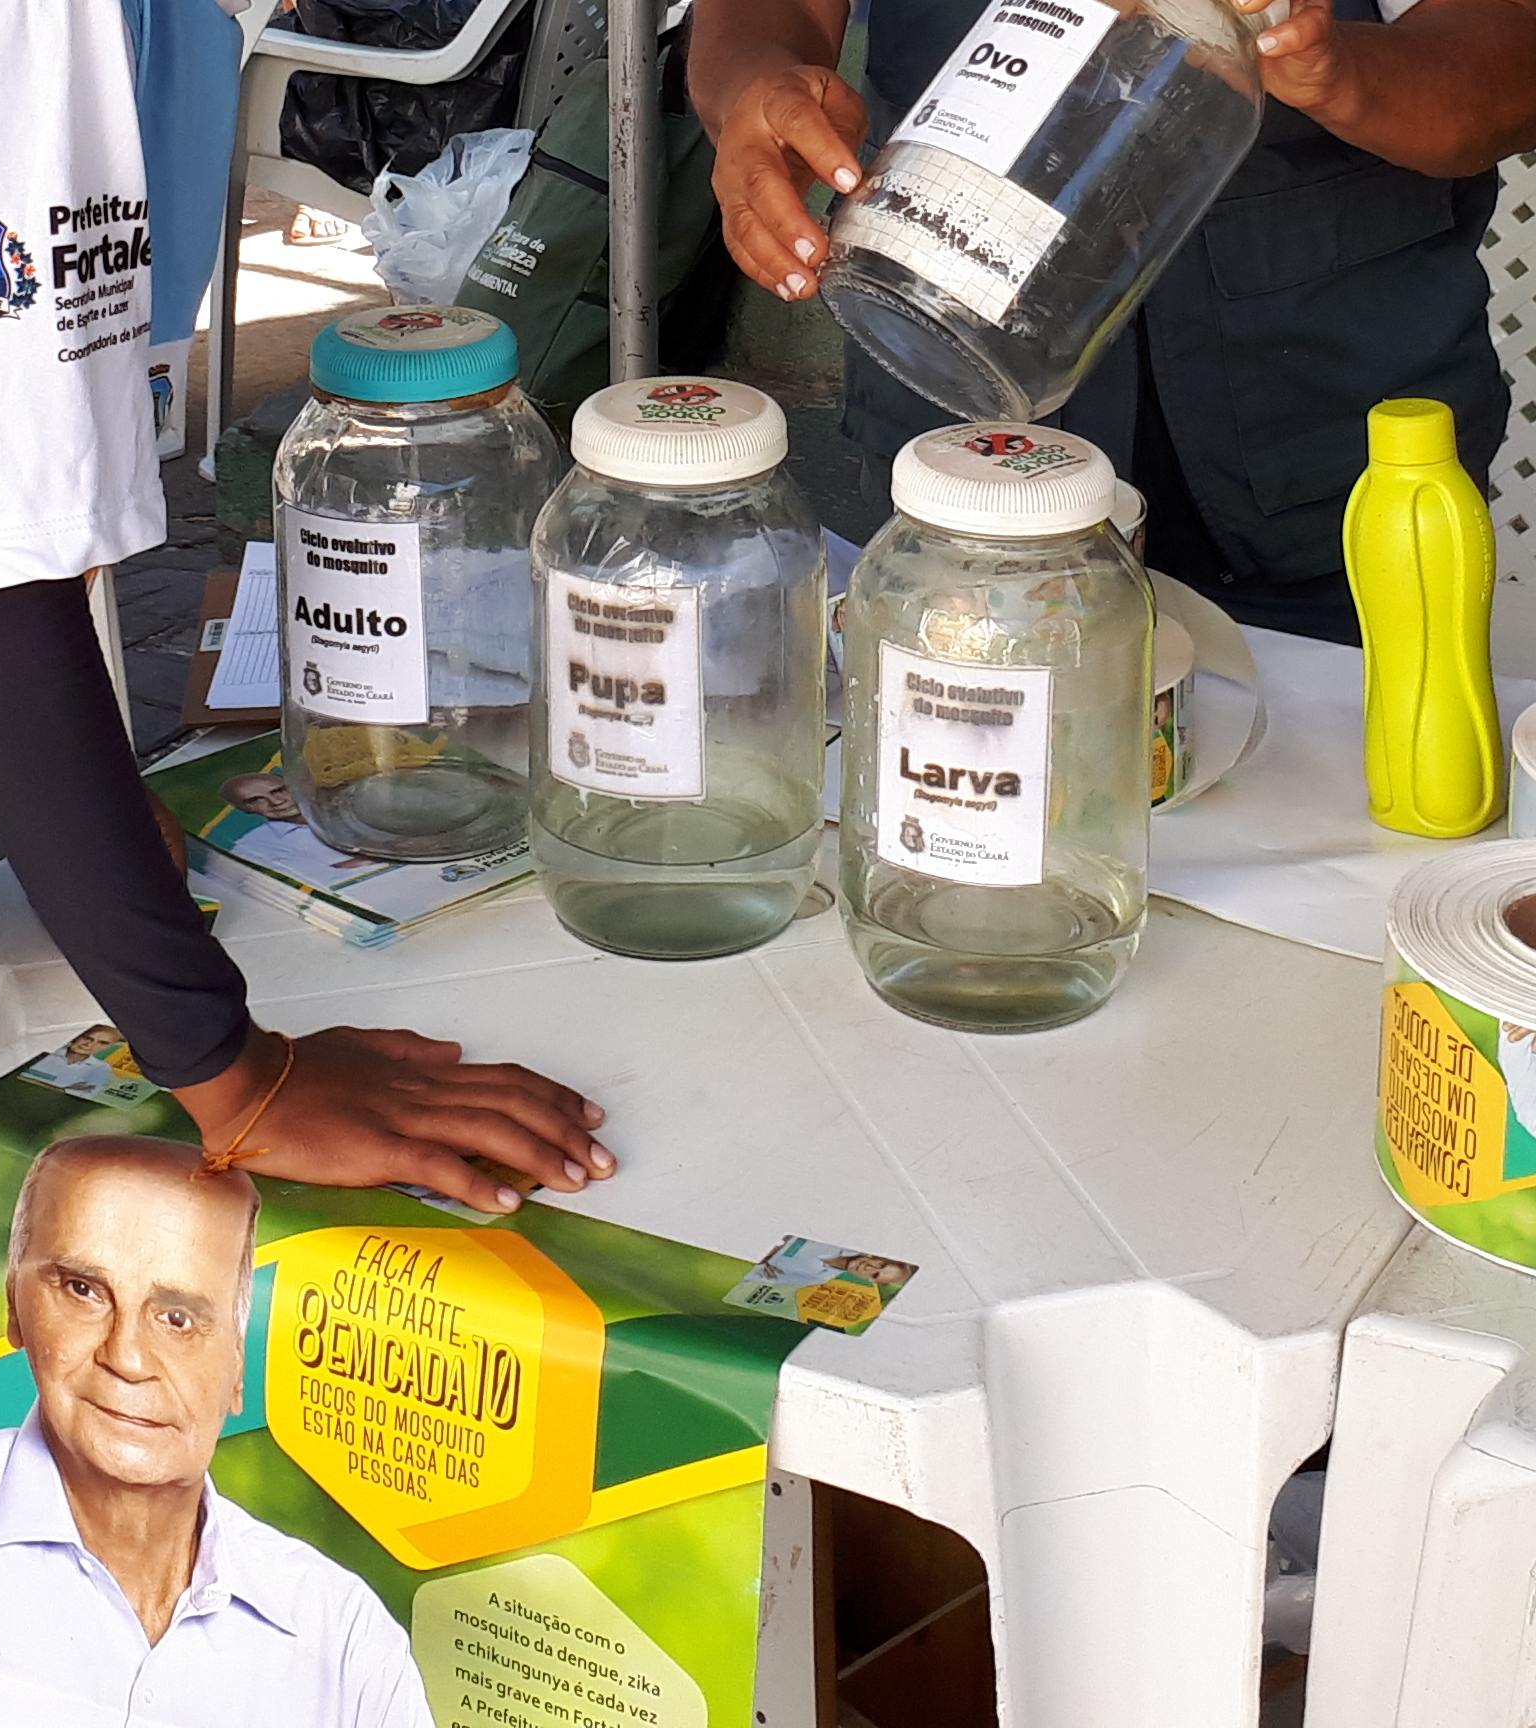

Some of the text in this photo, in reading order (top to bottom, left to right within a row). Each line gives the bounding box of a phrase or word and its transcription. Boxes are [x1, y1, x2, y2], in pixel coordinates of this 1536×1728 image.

[1009, 11, 1066, 40] mosquito
[968, 42, 1029, 78] Ovo
[56, 314, 75, 332] de
[100, 307, 108, 319] e
[641, 410, 717, 422] TODOS
[306, 550, 389, 576] do mosquito
[294, 595, 408, 638] Adulto
[568, 659, 666, 709] Pupa
[899, 746, 1022, 797] Larva
[1445, 1033, 1476, 1085] DE
[1387, 1069, 1478, 1160] O MOSQUITO
[1447, 1080, 1478, 1125] UM
[353, 1234, 444, 1294] FAÇA A
[330, 1269, 467, 1350] SUA PARTE.
[292, 1282, 328, 1368] 8
[326, 1316, 376, 1387] EM
[378, 1334, 467, 1418] CADA
[299, 1375, 485, 1459] FOCOS DO MOSQUITO
[302, 1404, 481, 1489] ESTÃO NA CASA DAS
[347, 1450, 433, 1504] PESSOAS.
[488, 1592, 626, 1656] A situação com o
[453, 1608, 662, 1698] mosquito da dengue, zika
[454, 1636, 658, 1726] e chikungunya é cada vez
[455, 1665, 570, 1721] mais grave em
